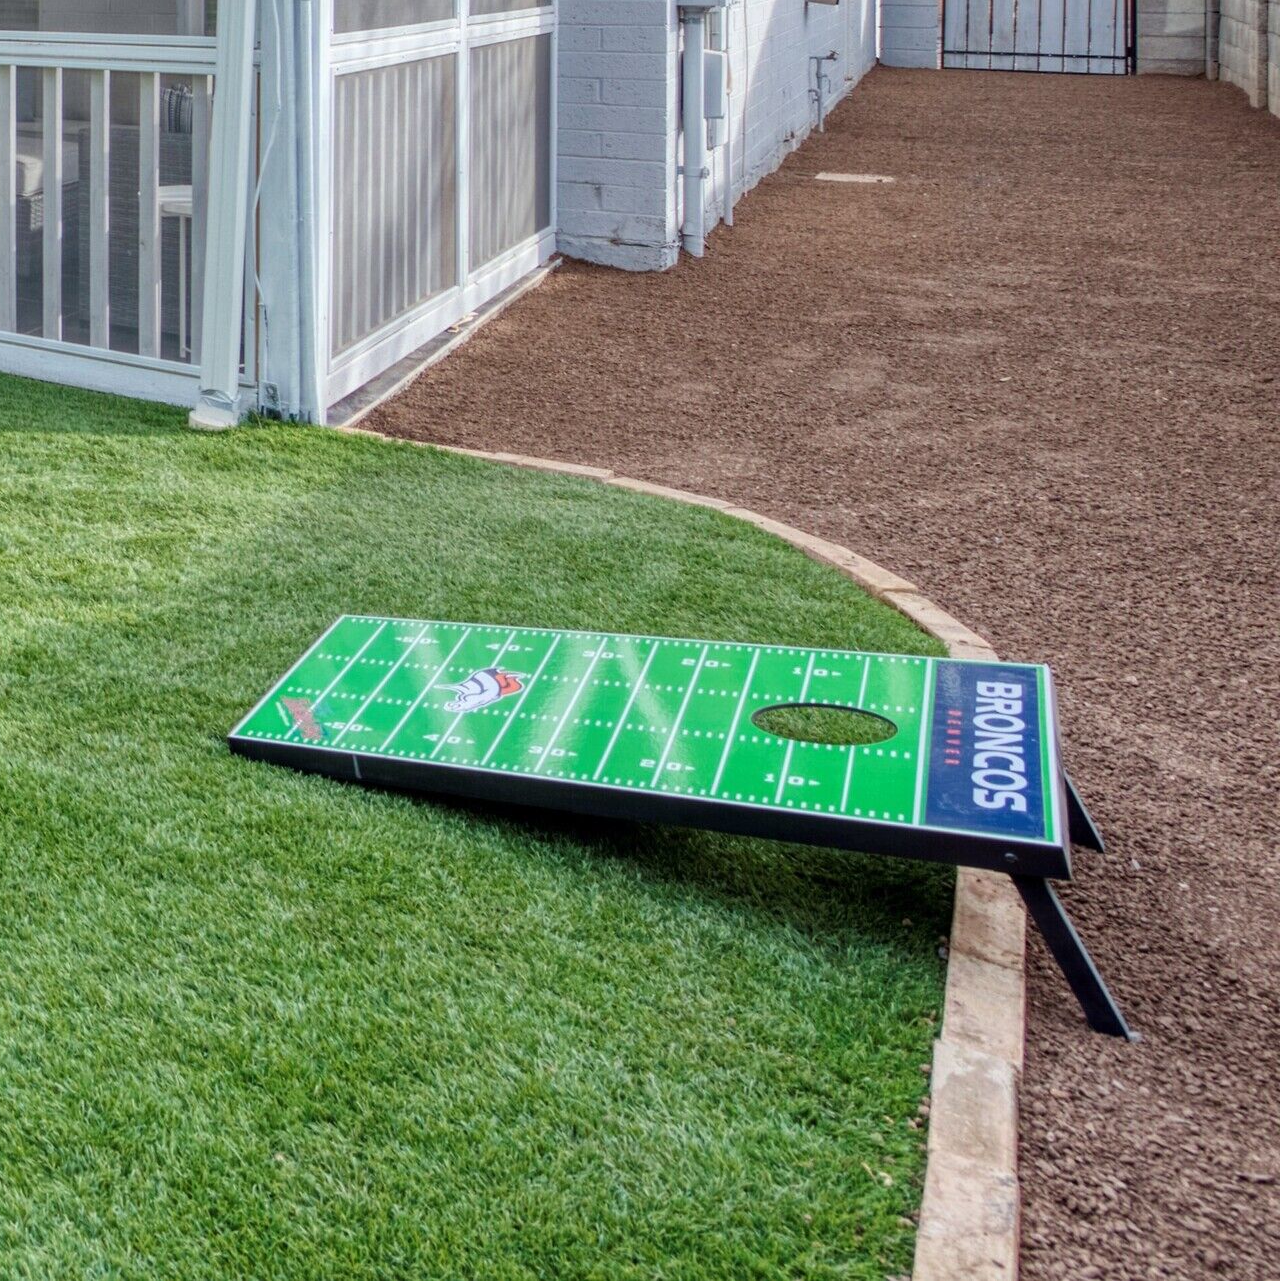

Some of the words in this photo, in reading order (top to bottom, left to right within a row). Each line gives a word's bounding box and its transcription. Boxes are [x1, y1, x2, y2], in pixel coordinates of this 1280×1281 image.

[485, 642, 520, 651] 40
[583, 650, 614, 659] 30
[682, 658, 721, 668] 20
[793, 666, 829, 677] 10
[422, 733, 461, 744] 40
[945, 709, 963, 766] DENVER
[528, 745, 566, 757] 30
[971, 681, 1028, 812] BRONCOS
[640, 758, 682, 771] 20
[764, 773, 805, 786] 10
